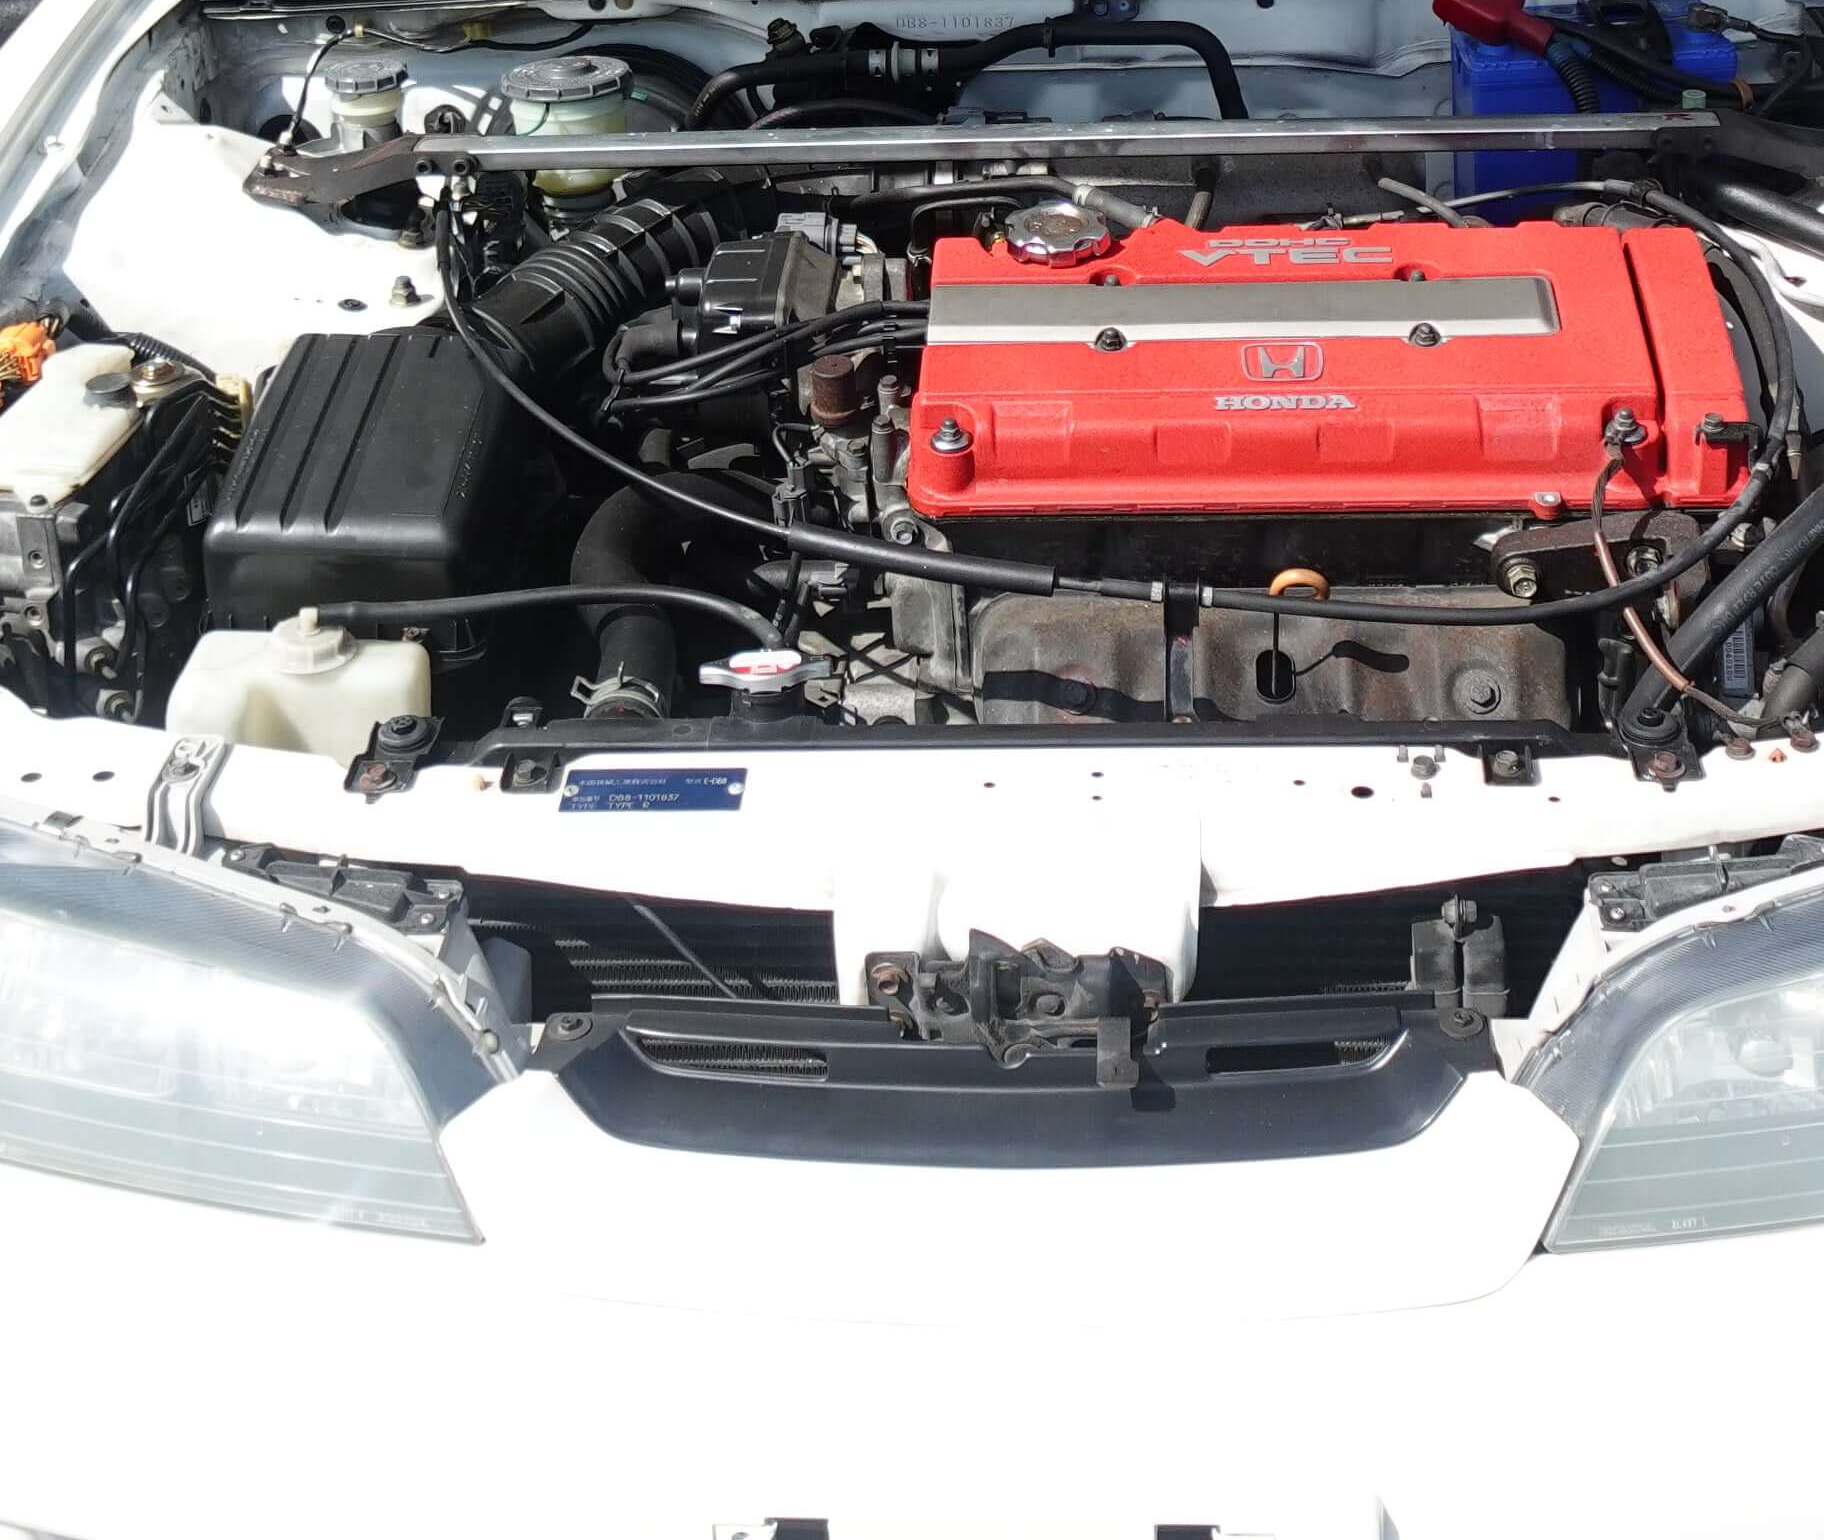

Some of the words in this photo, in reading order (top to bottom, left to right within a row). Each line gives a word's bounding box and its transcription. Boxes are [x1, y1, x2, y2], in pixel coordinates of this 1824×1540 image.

[1208, 237, 1352, 248] DOHC
[1180, 247, 1394, 267] VTEC
[1214, 393, 1356, 410] HONDA
